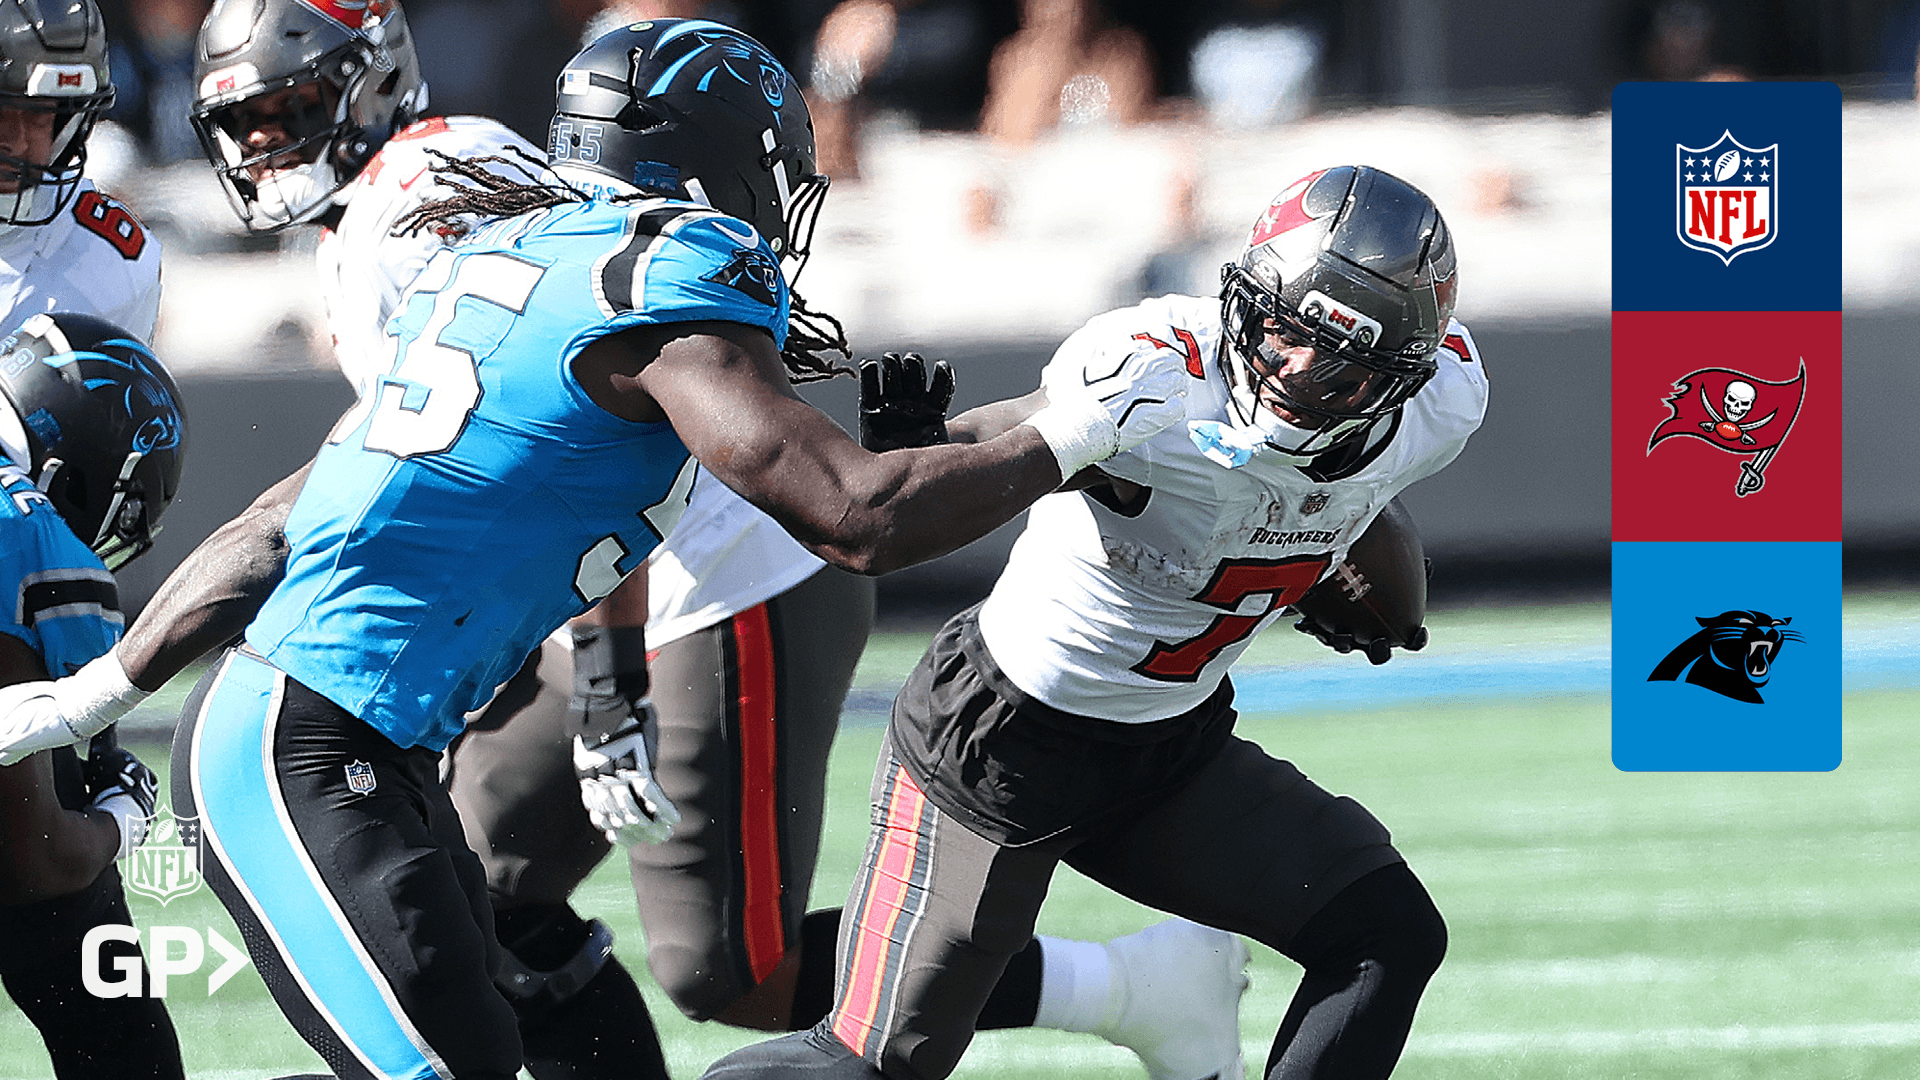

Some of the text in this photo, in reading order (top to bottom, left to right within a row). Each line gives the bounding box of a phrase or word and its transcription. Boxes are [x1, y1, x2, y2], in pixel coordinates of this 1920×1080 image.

[555, 123, 604, 165] 55
[1248, 527, 1342, 549] BUCCANEERS
[1129, 550, 1336, 683] 7
